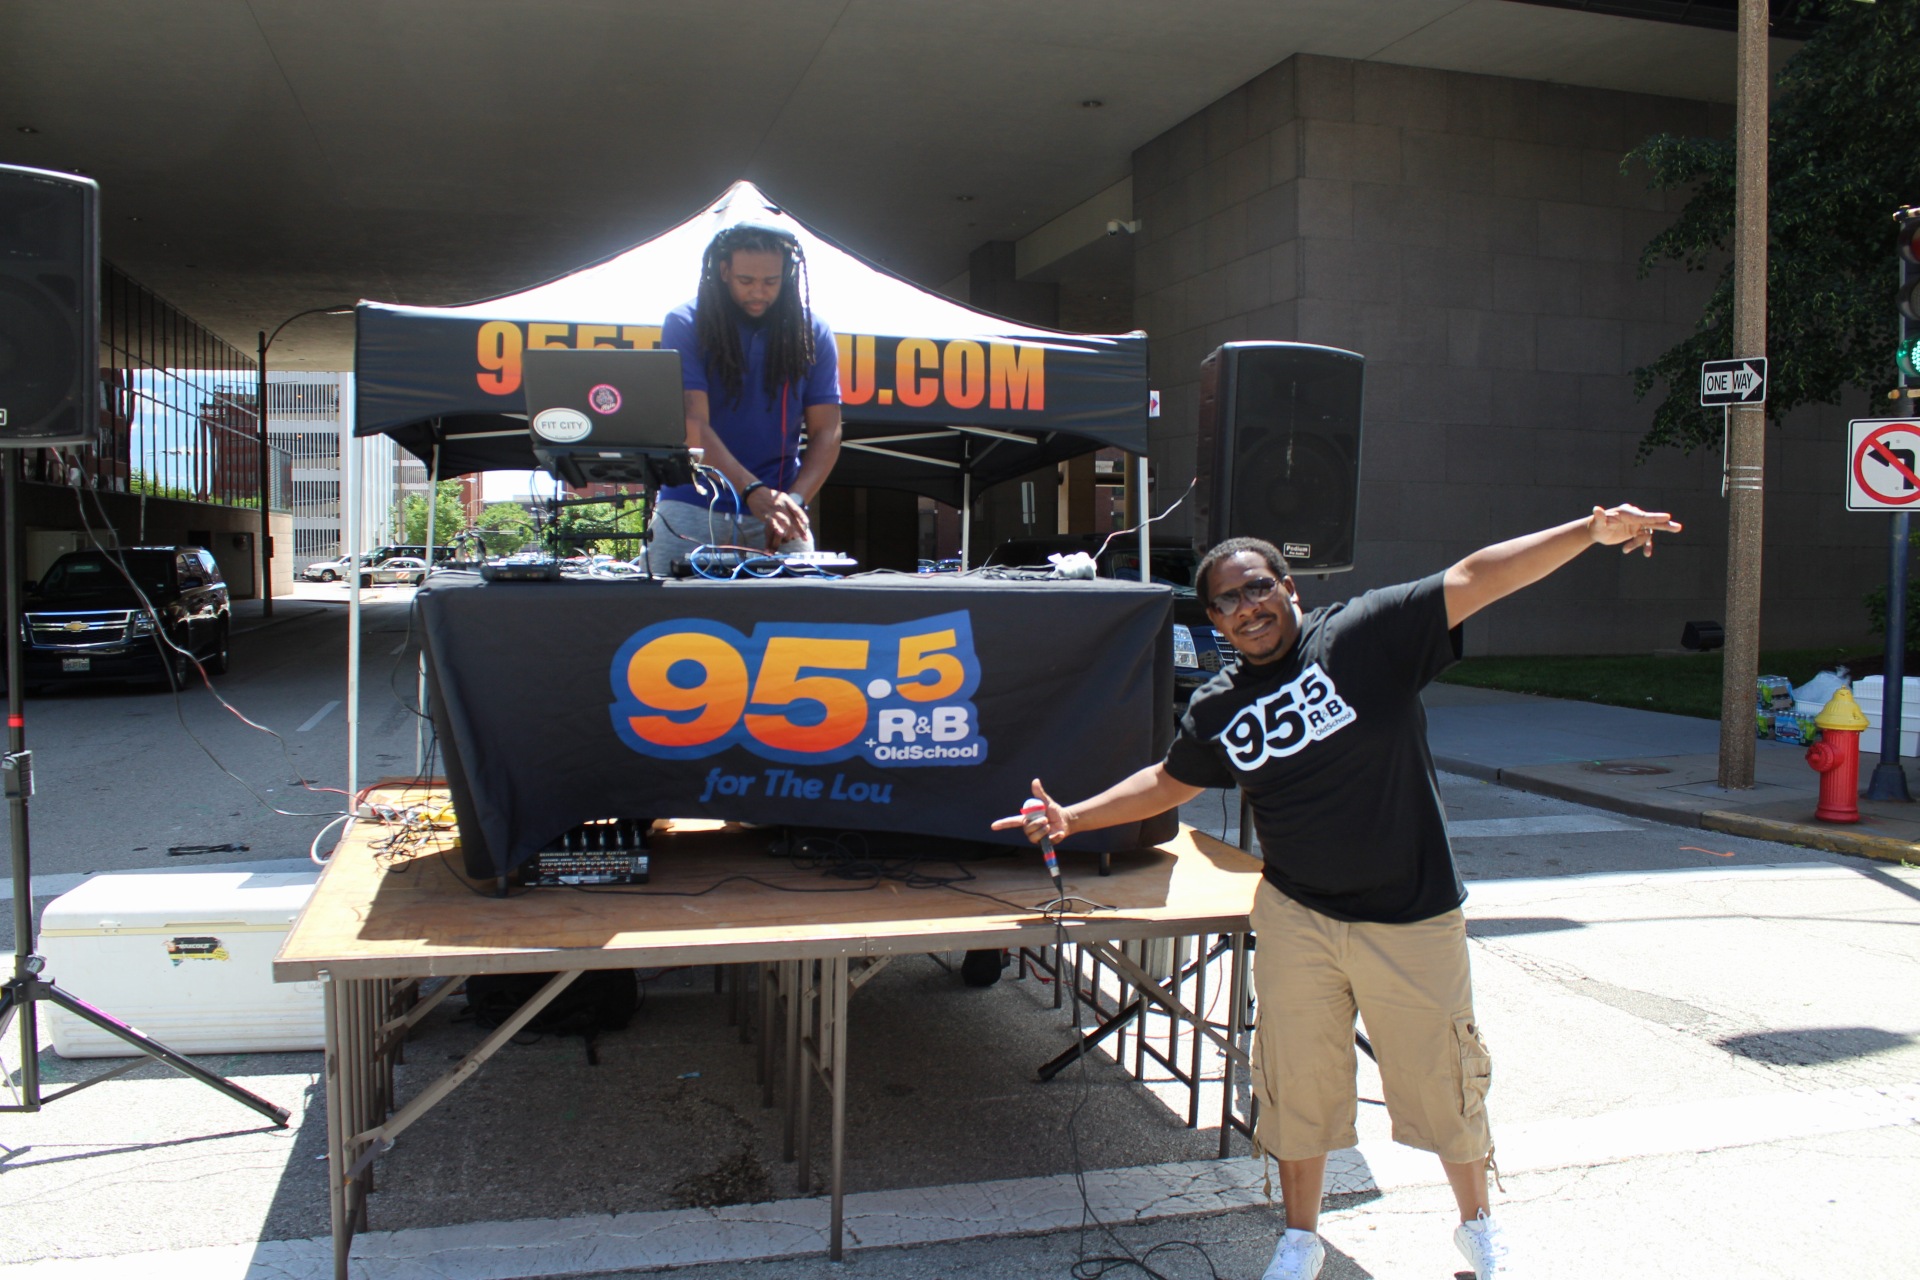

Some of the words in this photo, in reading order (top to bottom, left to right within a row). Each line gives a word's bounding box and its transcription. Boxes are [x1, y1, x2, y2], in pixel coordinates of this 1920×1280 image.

[1707, 375, 1728, 392] ONE
[1734, 372, 1753, 390] WAY
[541, 421, 557, 430] FIT
[559, 421, 583, 431] CITY
[627, 629, 965, 753] 95.5
[878, 707, 970, 743] R&B
[1225, 672, 1328, 764] 95.5
[1307, 699, 1342, 728] R&B
[700, 768, 755, 803] for
[764, 769, 823, 800] The
[829, 773, 893, 804] Lou
